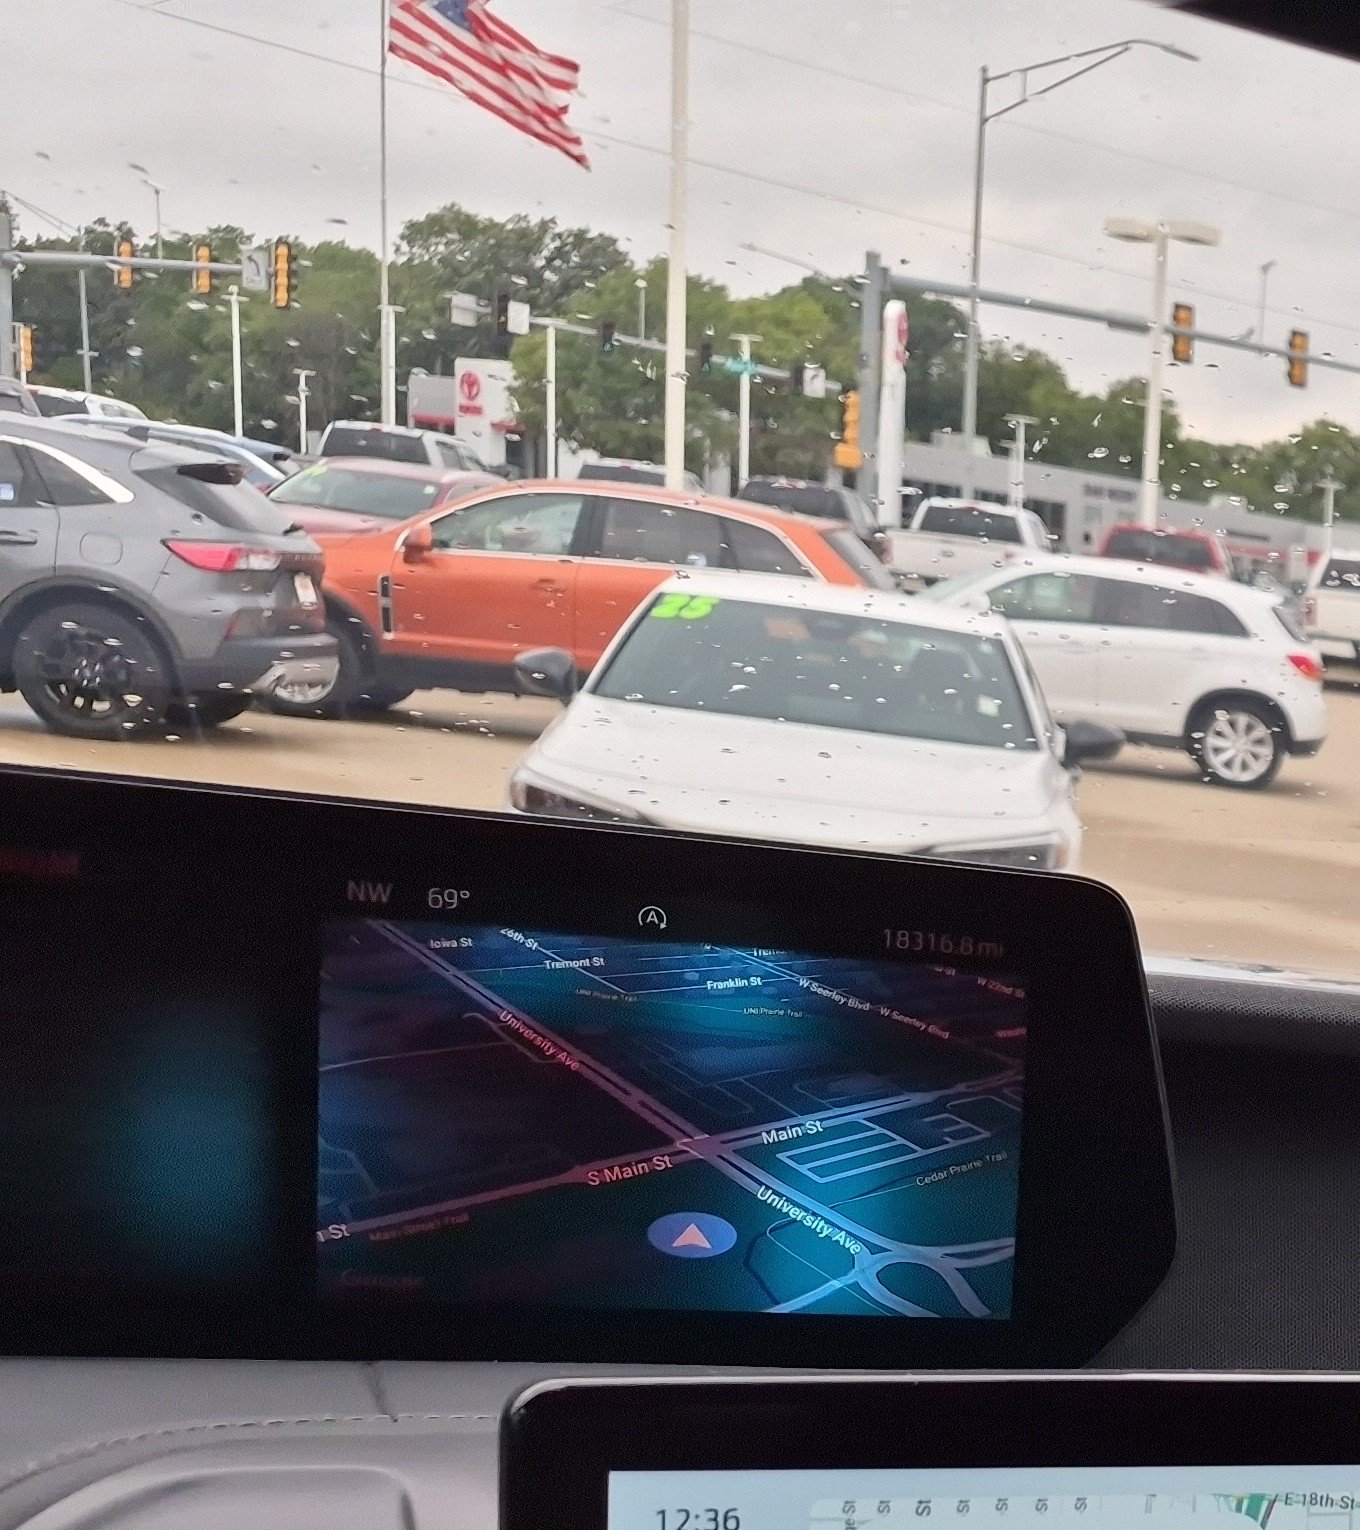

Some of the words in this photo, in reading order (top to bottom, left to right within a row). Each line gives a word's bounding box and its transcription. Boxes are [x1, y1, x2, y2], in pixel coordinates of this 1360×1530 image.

[650, 593, 720, 620] 25
[348, 881, 393, 904] NW
[428, 887, 471, 909] 69°
[430, 938, 458, 949] Iowa
[460, 936, 473, 947] St
[543, 958, 590, 970] Tremont
[592, 956, 605, 967] St
[706, 977, 749, 991] Franklin
[749, 976, 763, 987] St
[798, 977, 811, 989] W
[809, 981, 848, 1006] Seerley
[847, 997, 871, 1012] Blvd
[500, 1009, 558, 1056] University
[556, 1051, 580, 1071] Ave
[761, 1126, 803, 1145] Main
[801, 1119, 824, 1135] St
[586, 1170, 602, 1187] S
[602, 1160, 650, 1184] Main
[651, 1153, 674, 1171] St
[916, 1171, 948, 1186] Cedar
[756, 1184, 834, 1239] University
[831, 1230, 862, 1255] Ave
[1284, 1493, 1296, 1507] E
[1298, 1492, 1339, 1510] 18th
[1339, 1495, 1355, 1511] St
